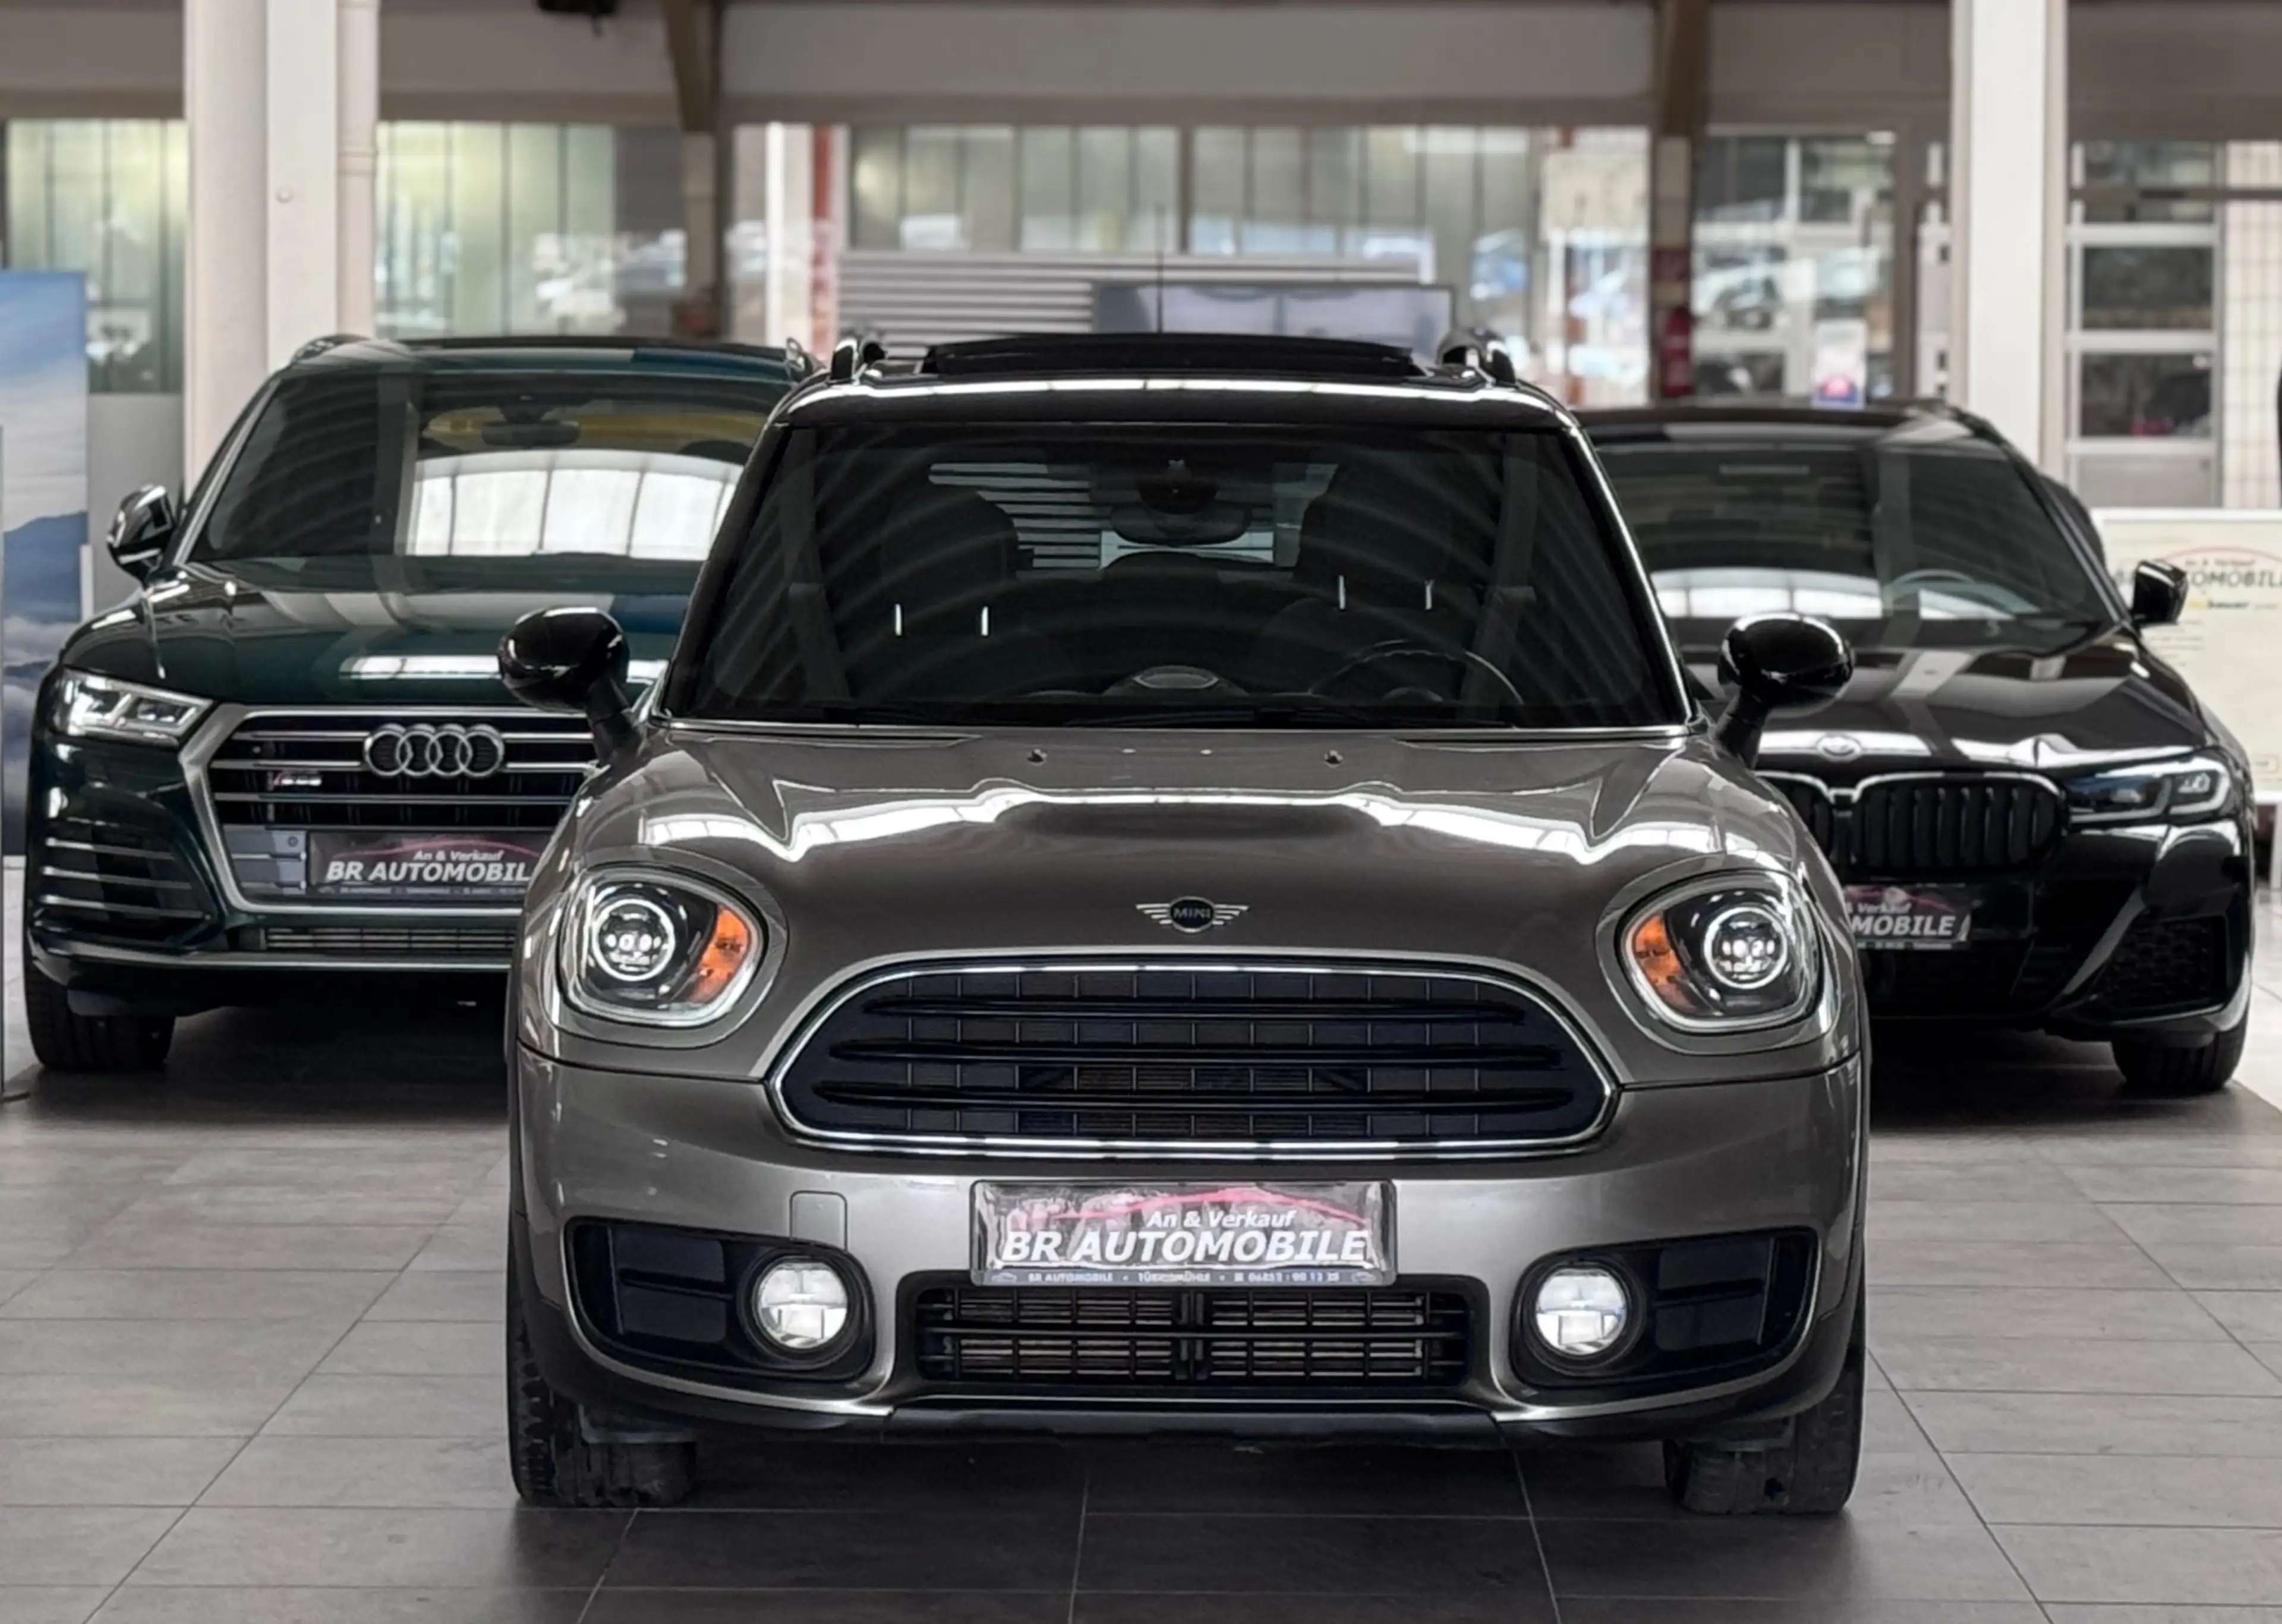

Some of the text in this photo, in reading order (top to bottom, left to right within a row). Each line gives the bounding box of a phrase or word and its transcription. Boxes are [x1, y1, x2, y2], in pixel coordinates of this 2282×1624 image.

[413, 850, 433, 860] An
[450, 850, 505, 861] Verkauf
[326, 861, 531, 882] BR AUTOMOBIL
[1173, 907, 1211, 919] MINI
[1852, 915, 1956, 936] MOBILE
[1146, 1210, 1295, 1228] An & Verkauf
[1001, 1229, 1370, 1263] BR AUTOMOBILE
